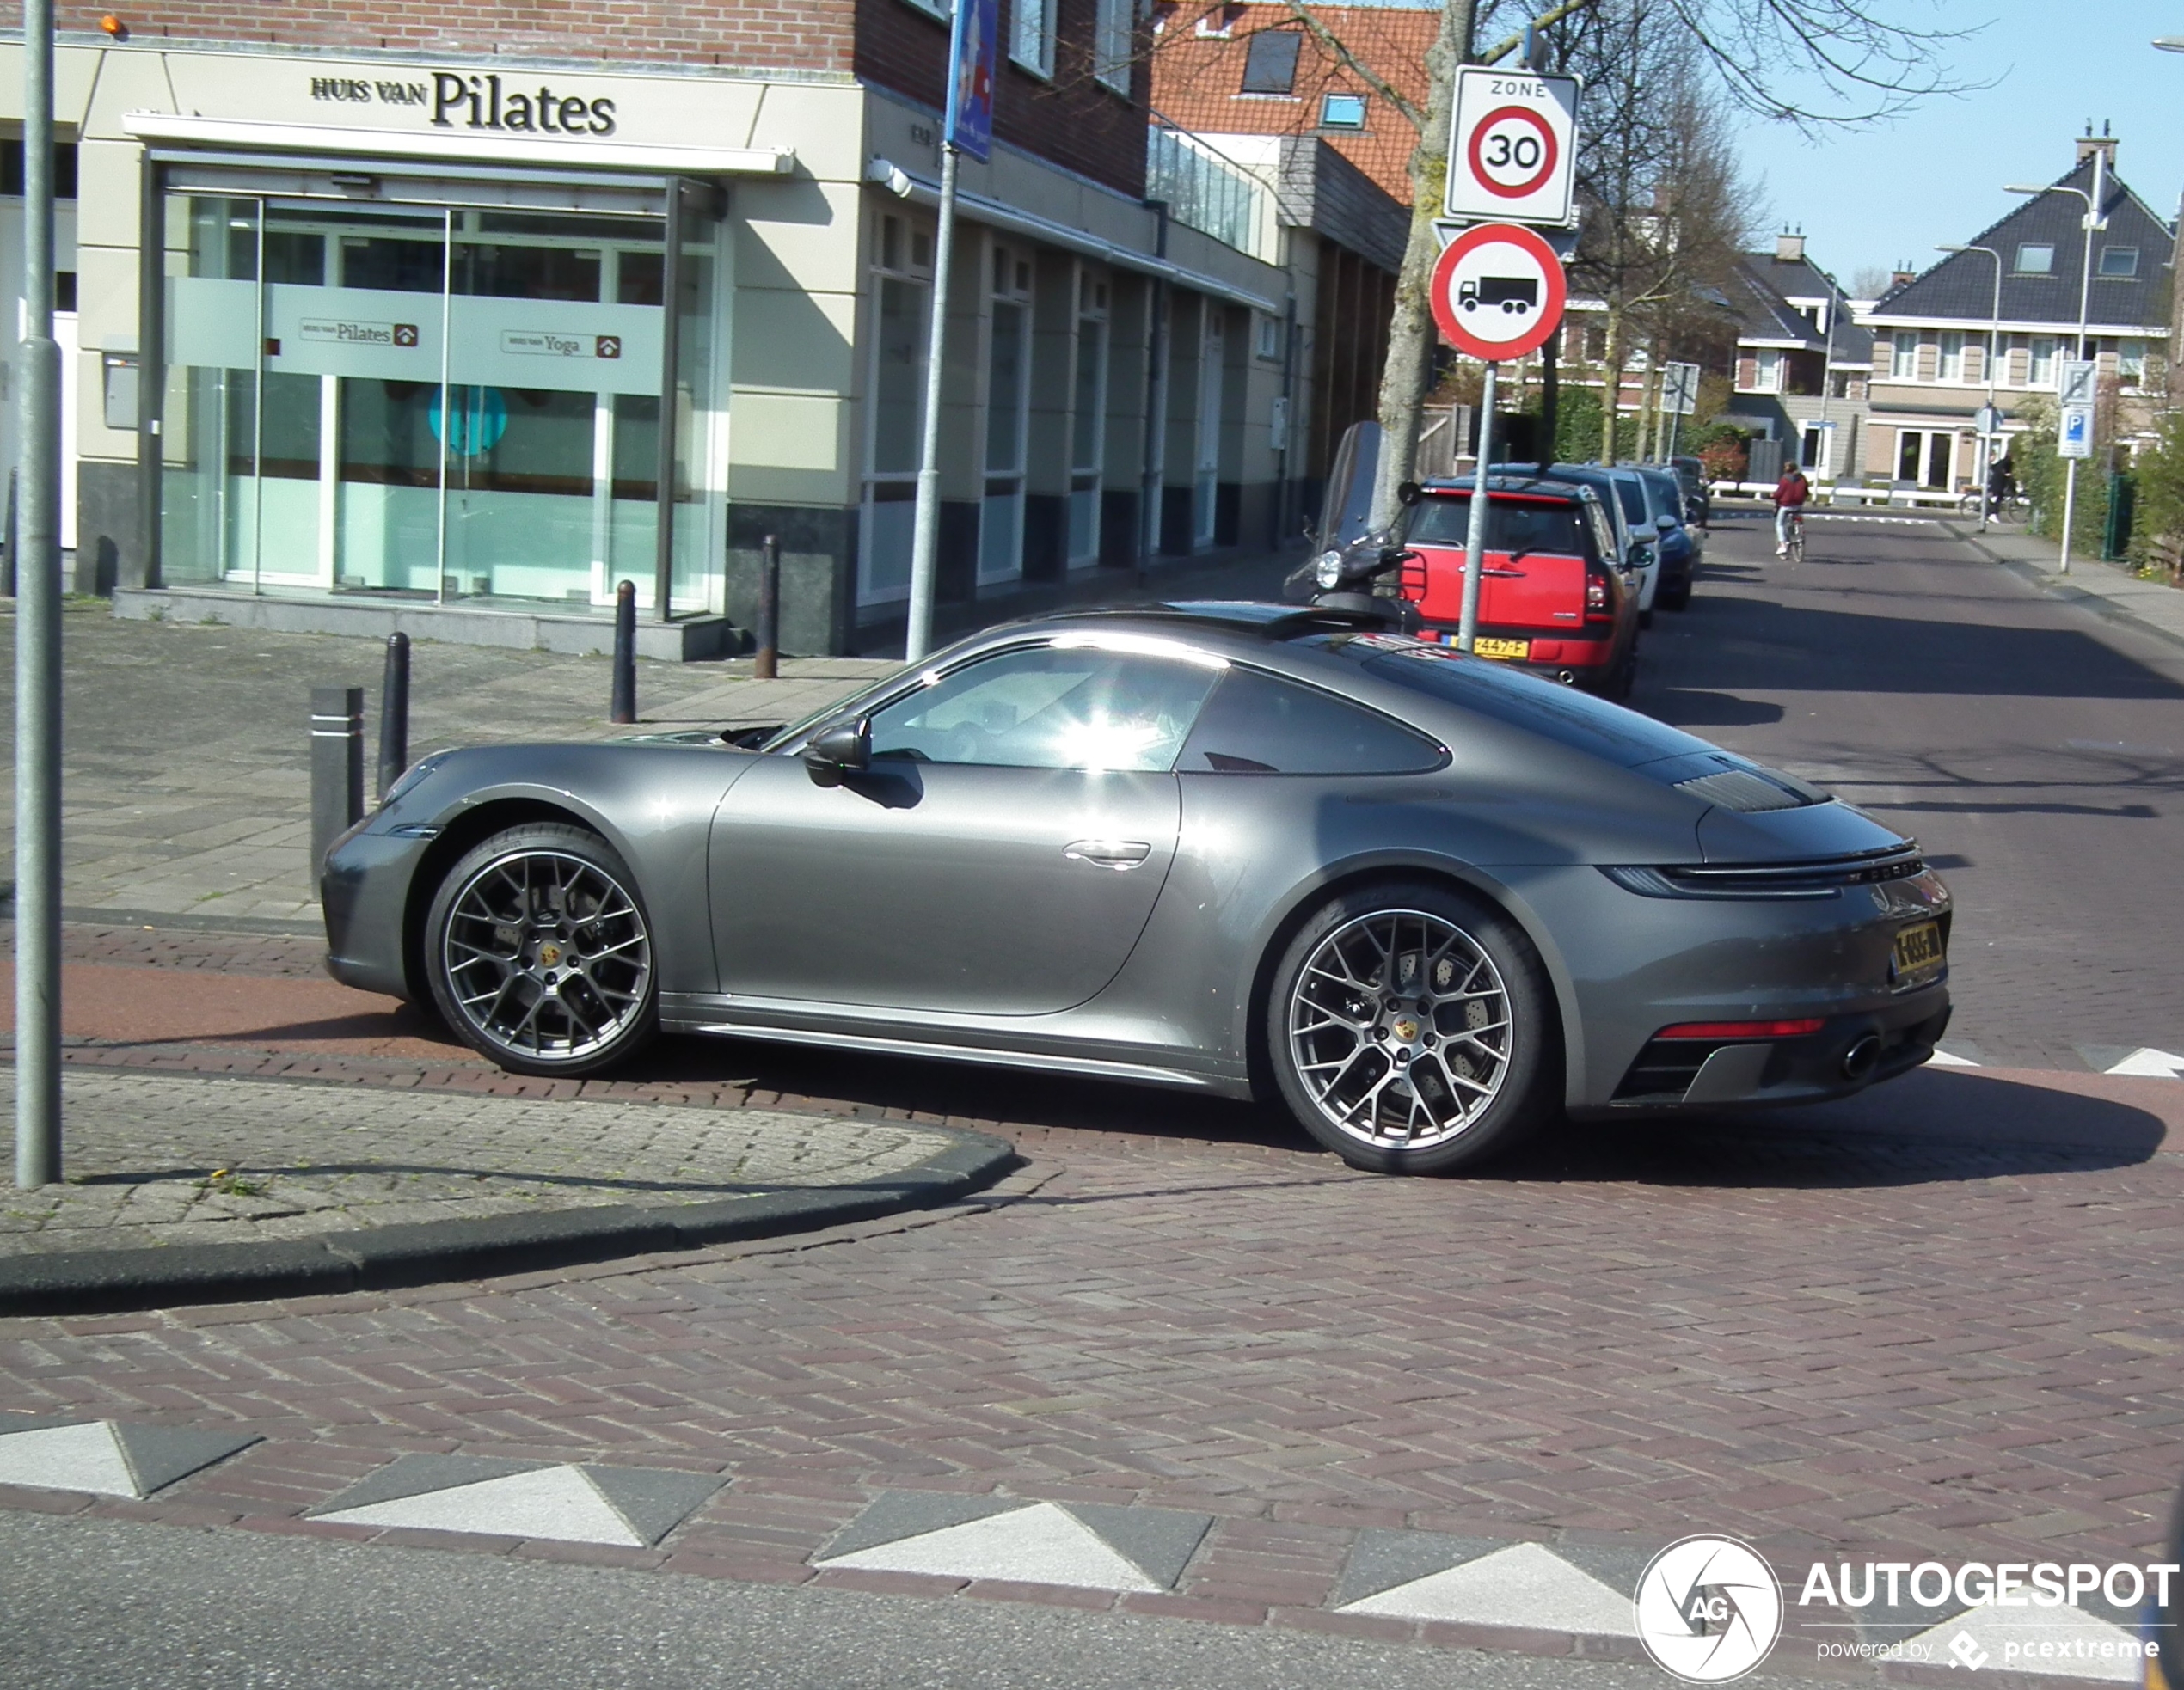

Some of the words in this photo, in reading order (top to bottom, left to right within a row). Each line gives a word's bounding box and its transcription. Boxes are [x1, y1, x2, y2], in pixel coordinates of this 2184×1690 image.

[1491, 80, 1546, 97] ZONE
[310, 77, 371, 103] HUIS
[374, 81, 428, 107] VAN
[430, 71, 617, 136] Pilates
[1486, 134, 1541, 169] 30
[337, 323, 390, 342] Pilates
[544, 336, 580, 356] Yoga
[2069, 416, 2082, 431] P
